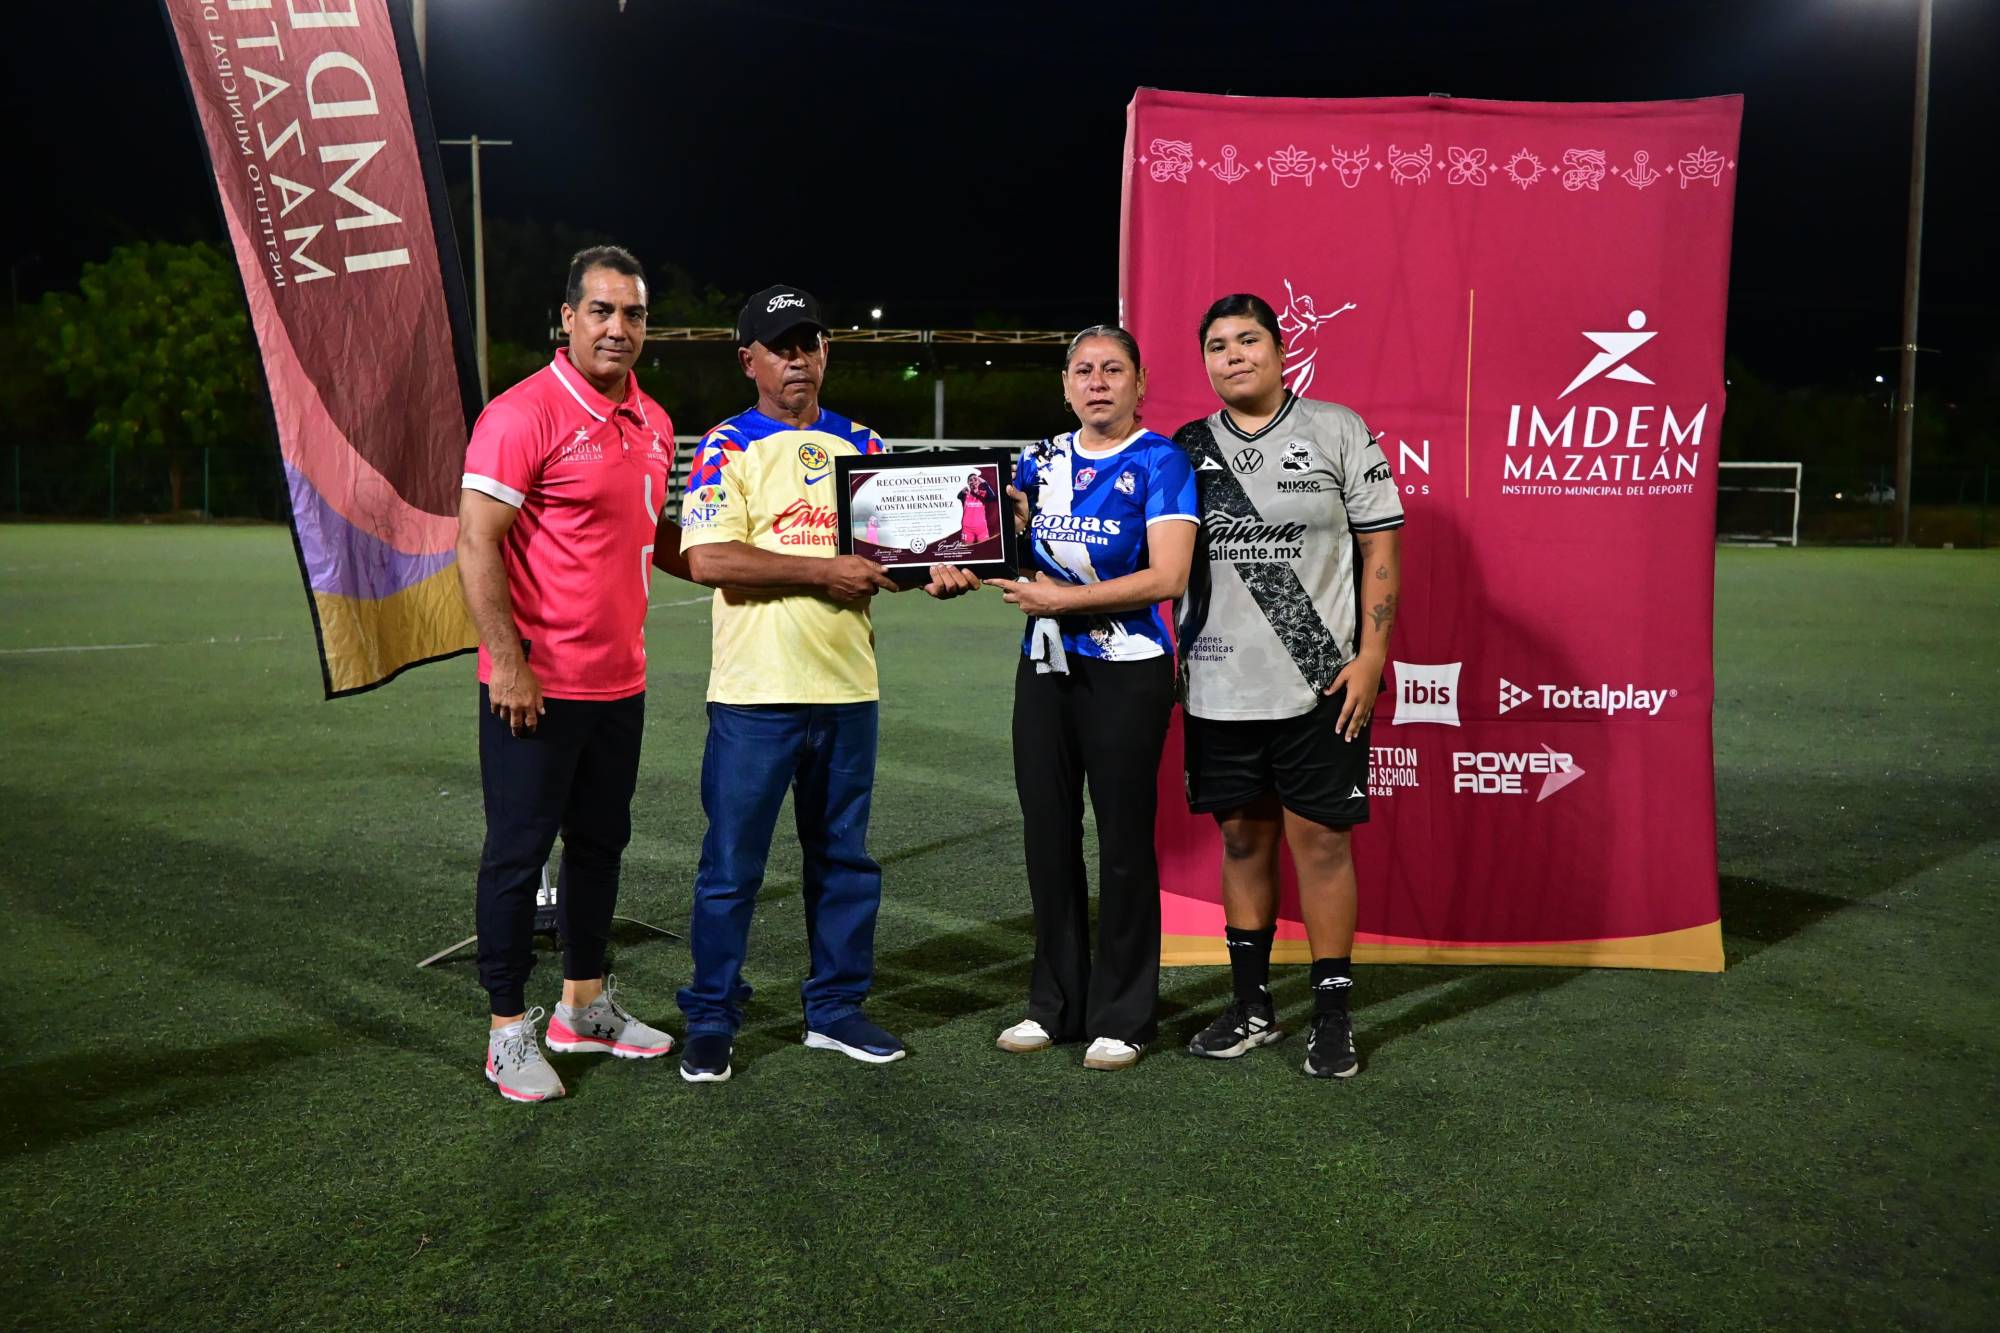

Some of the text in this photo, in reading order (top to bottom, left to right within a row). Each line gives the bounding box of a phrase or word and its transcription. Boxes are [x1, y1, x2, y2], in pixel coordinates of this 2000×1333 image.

[766, 293, 806, 313] Ford
[1507, 402, 1708, 448] IMDEM
[1503, 447, 1699, 481] MAZATLÁN
[876, 475, 962, 488] RECONOCIMIENTO
[1502, 484, 1695, 496] INSTITUTO MUNICIPAL DEL DEPORTE
[874, 503, 905, 512] ACOSTA
[917, 493, 944, 502] ISABEL
[1031, 513, 1121, 535] eonas
[1208, 545, 1303, 561] aliente.mx
[1198, 636, 1223, 645] genes
[1403, 679, 1450, 704] ibis
[1368, 746, 1418, 767] ETTON
[1452, 751, 1574, 774] POWER
[1379, 767, 1420, 787] SCHOOL
[1454, 773, 1523, 794] ADE
[1368, 786, 1393, 796] R&B
